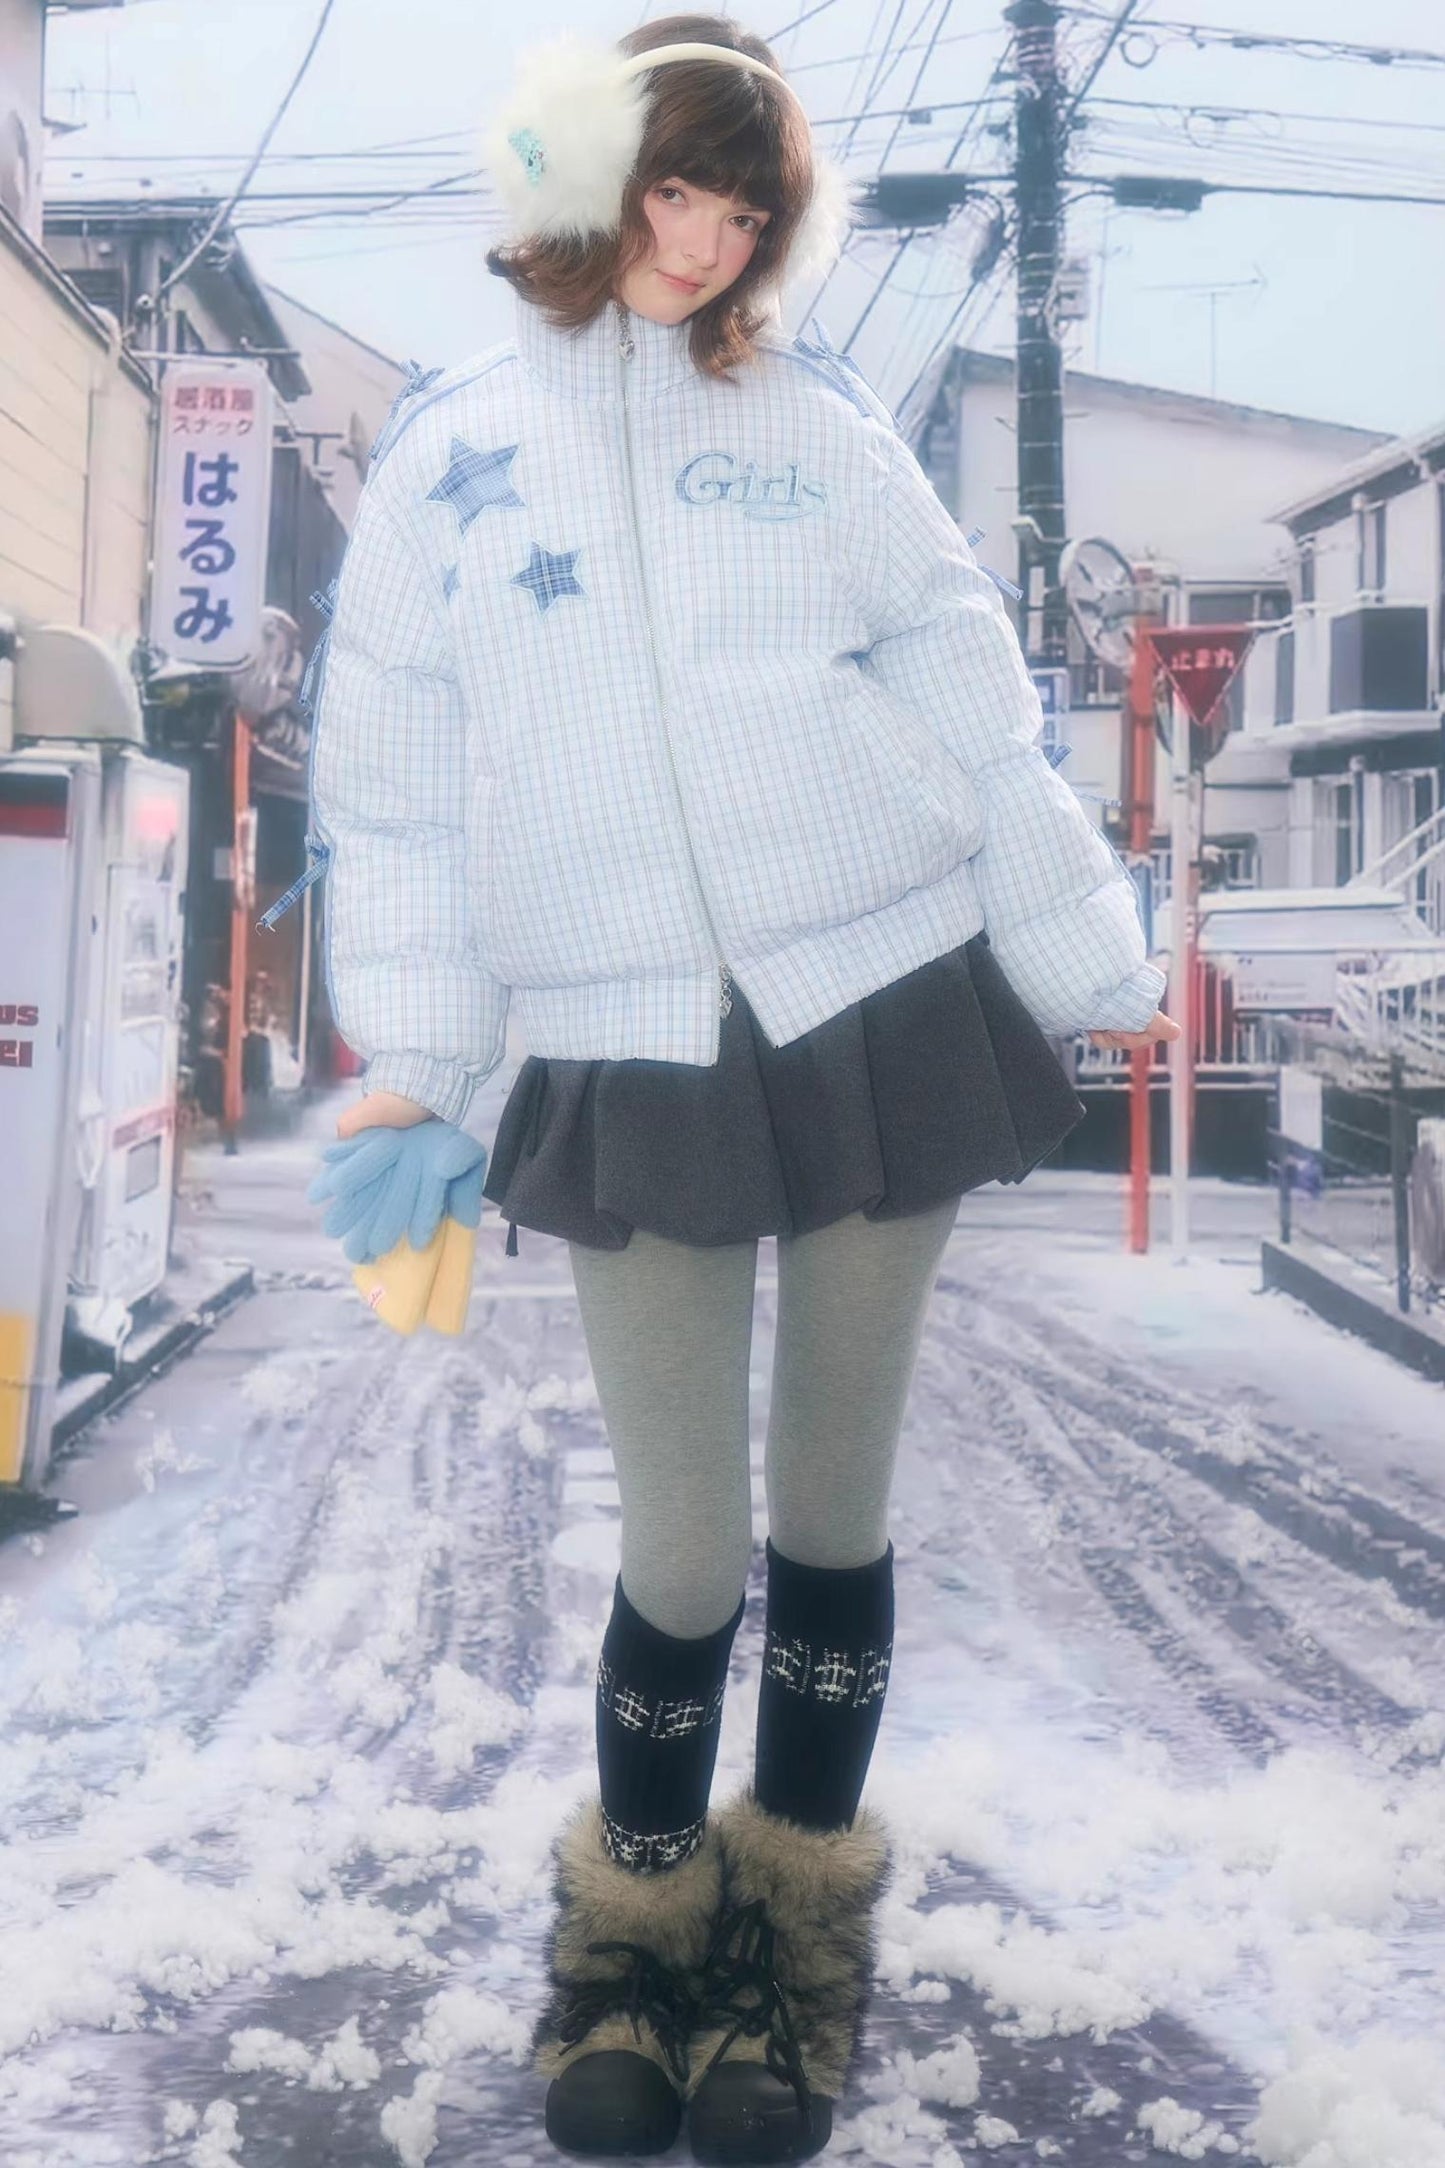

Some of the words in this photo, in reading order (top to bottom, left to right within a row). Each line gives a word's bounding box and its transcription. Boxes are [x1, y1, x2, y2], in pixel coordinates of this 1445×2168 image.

[174, 452, 239, 643] はるみ
[674, 452, 827, 521] Girls
